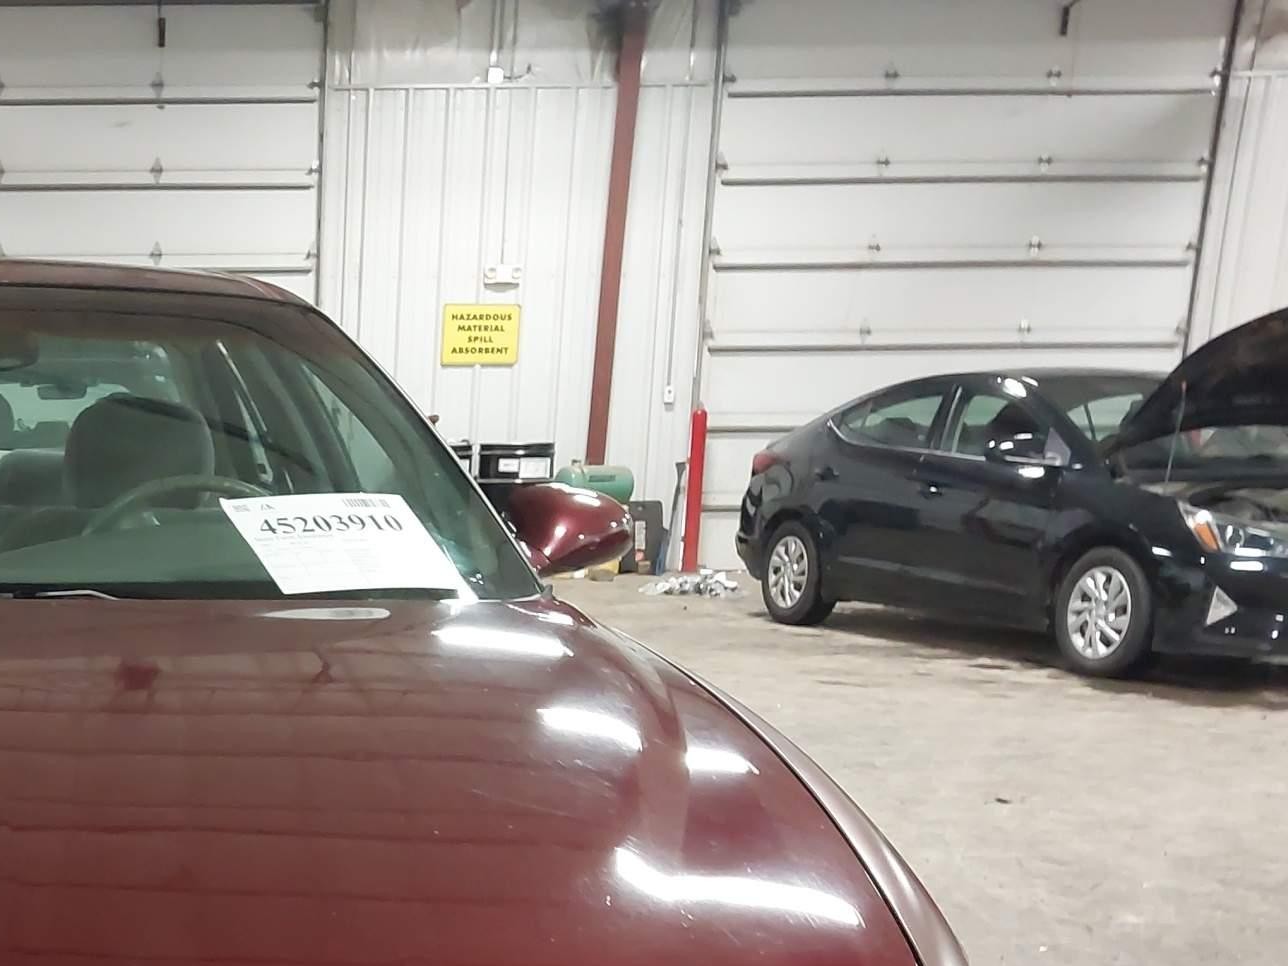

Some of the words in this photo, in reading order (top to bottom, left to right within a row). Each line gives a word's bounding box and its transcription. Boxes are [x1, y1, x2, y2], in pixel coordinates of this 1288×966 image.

[451, 313, 513, 321] HAZARDOUS
[450, 346, 509, 354] ABSORBENT
[259, 513, 404, 535] 45203910
